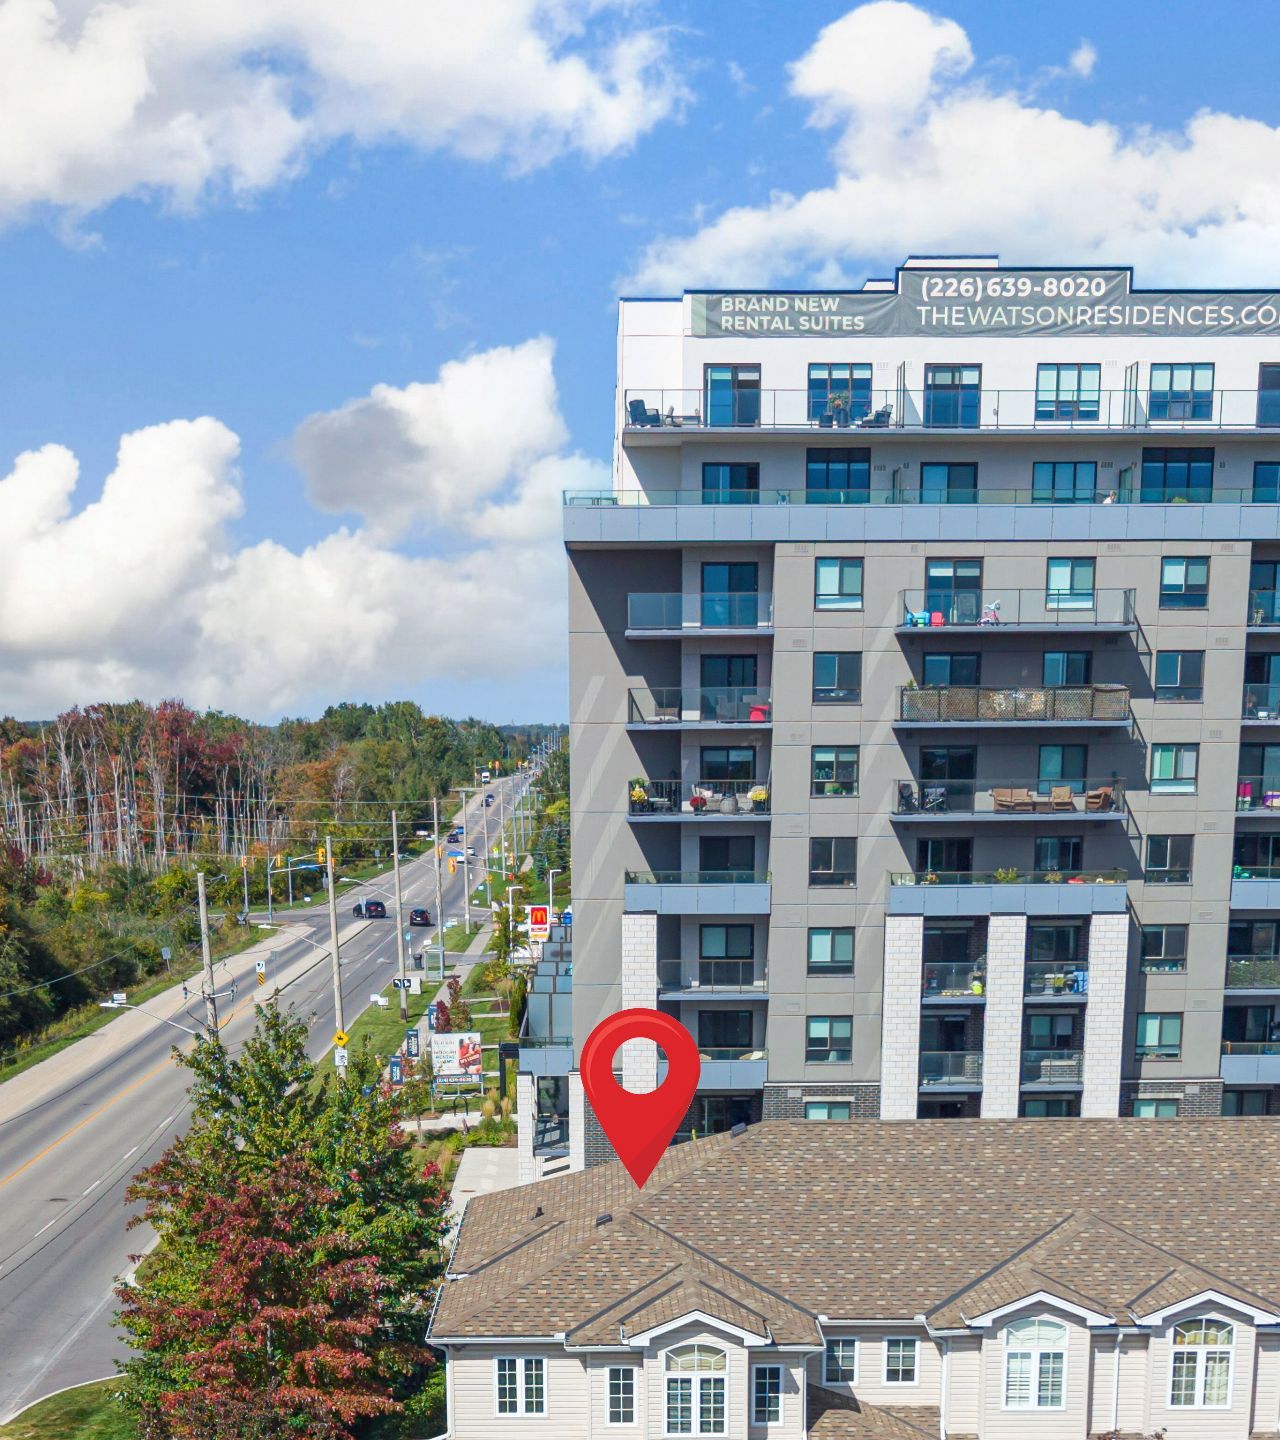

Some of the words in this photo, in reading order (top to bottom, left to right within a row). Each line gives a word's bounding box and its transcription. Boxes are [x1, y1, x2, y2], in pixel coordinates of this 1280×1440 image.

[721, 297, 789, 312] BRAND
[794, 297, 840, 312] NEW
[721, 315, 795, 331] RENTAL
[799, 315, 865, 331] SUITES
